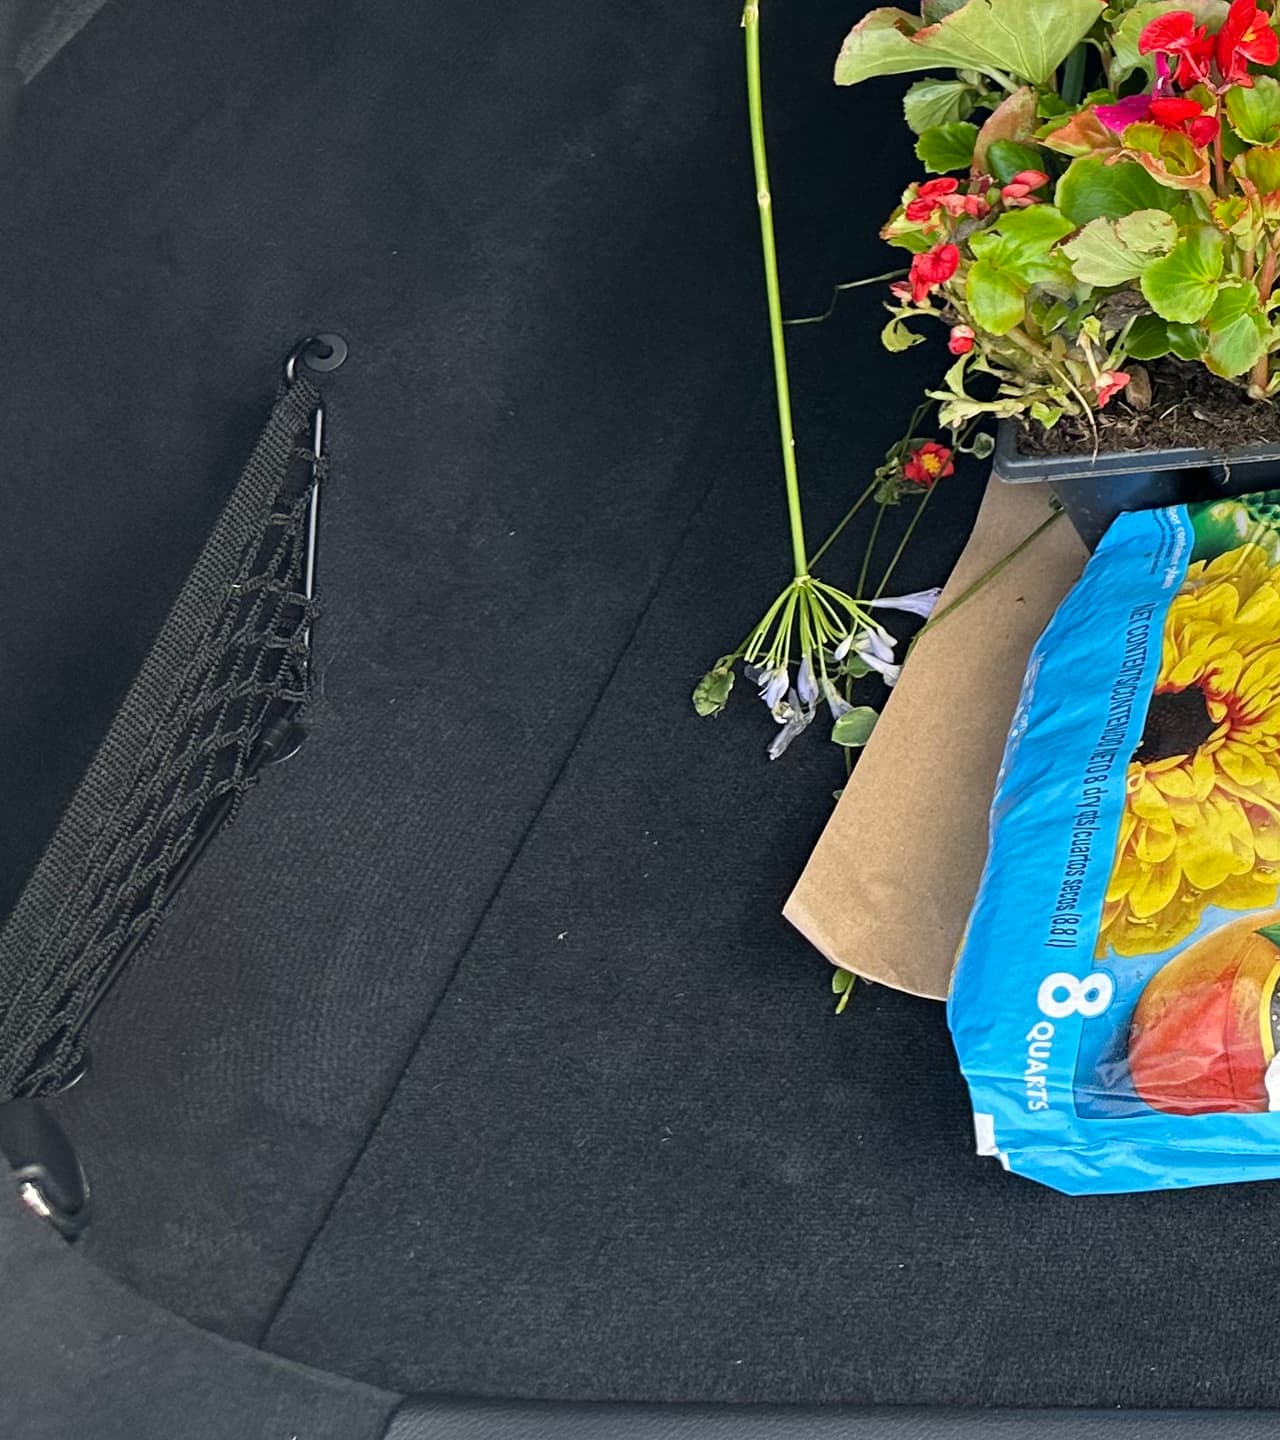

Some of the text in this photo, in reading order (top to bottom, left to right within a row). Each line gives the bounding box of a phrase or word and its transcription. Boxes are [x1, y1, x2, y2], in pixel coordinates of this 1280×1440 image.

[1129, 602, 1157, 626] NET
[1086, 748, 1118, 773] NETO
[1083, 775, 1108, 784] 8
[1076, 787, 1108, 807] dry
[1065, 809, 1101, 877] qts/cuartos
[1056, 880, 1082, 911] secos
[1049, 913, 1083, 937] (8.8
[1037, 972, 1113, 1018] 8
[1024, 1021, 1055, 1111] QUARTS
